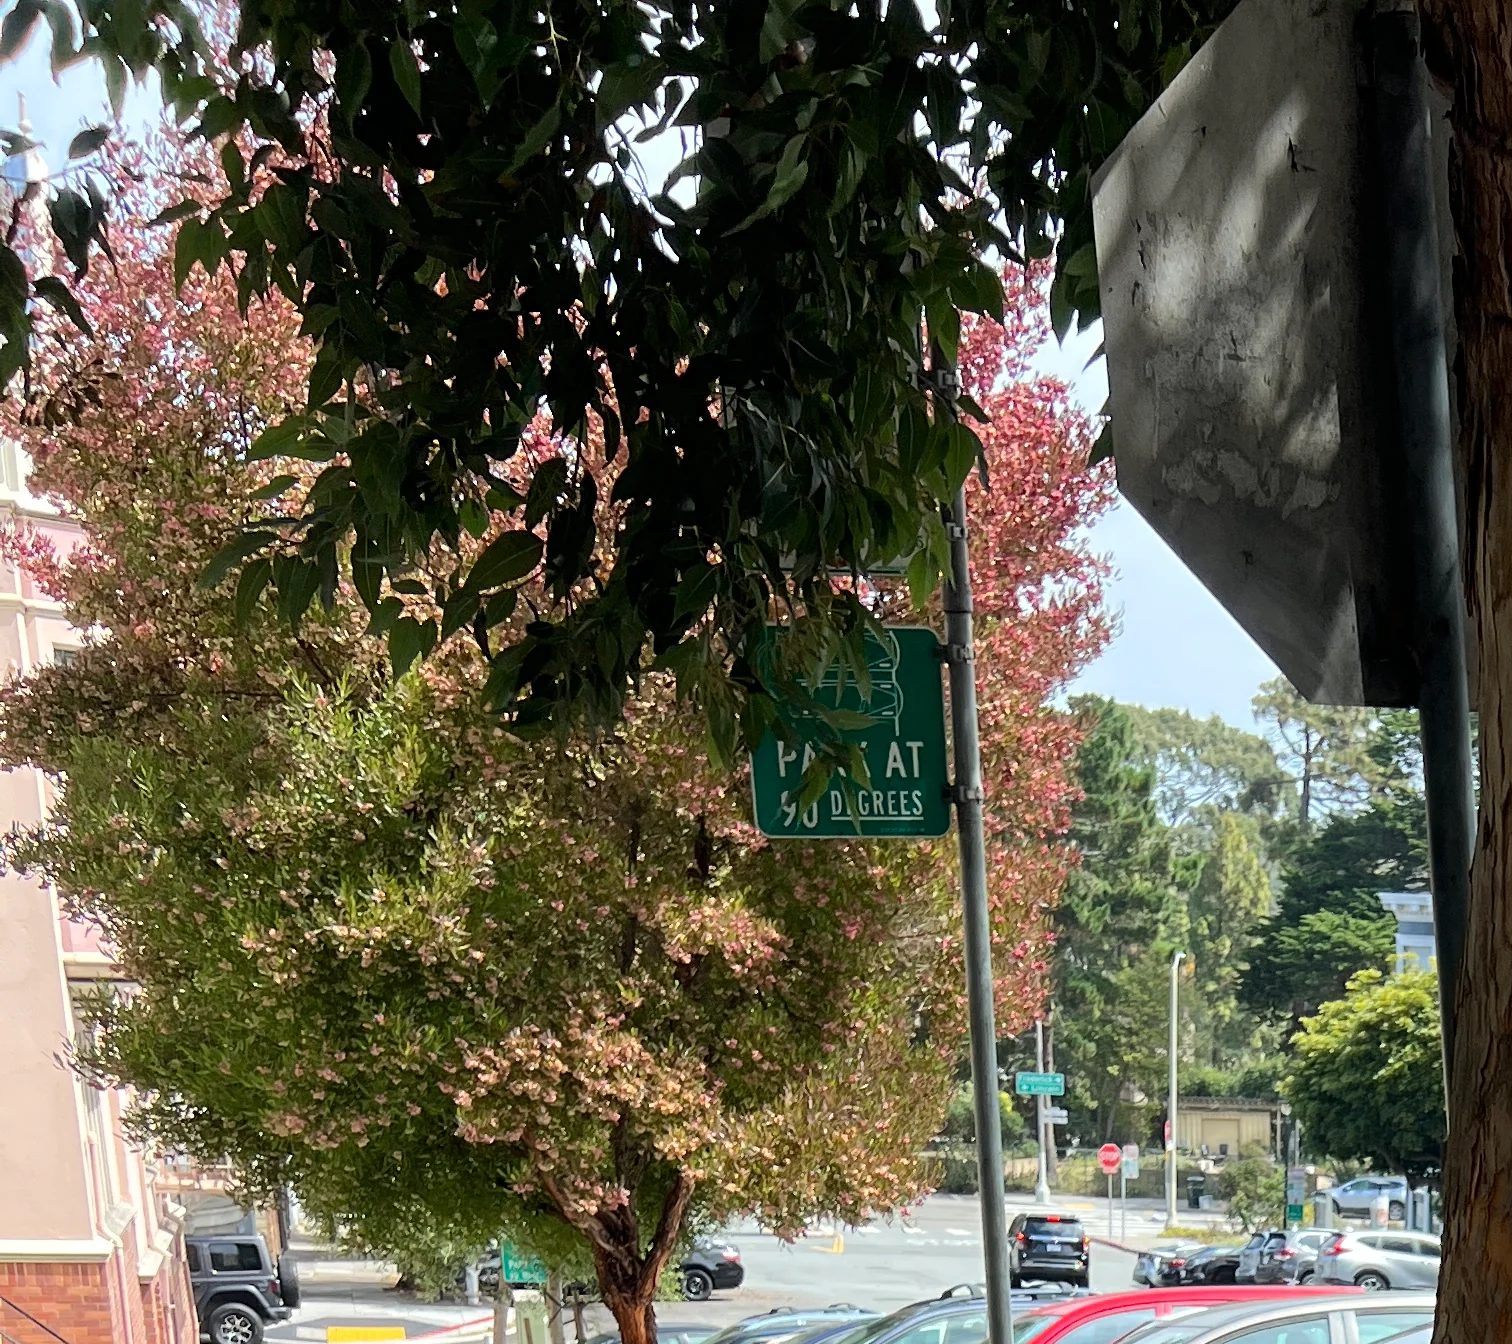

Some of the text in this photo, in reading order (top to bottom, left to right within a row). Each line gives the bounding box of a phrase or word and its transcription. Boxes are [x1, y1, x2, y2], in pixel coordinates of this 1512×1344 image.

[777, 741, 924, 778] PA AT
[830, 789, 924, 816] DGREES
